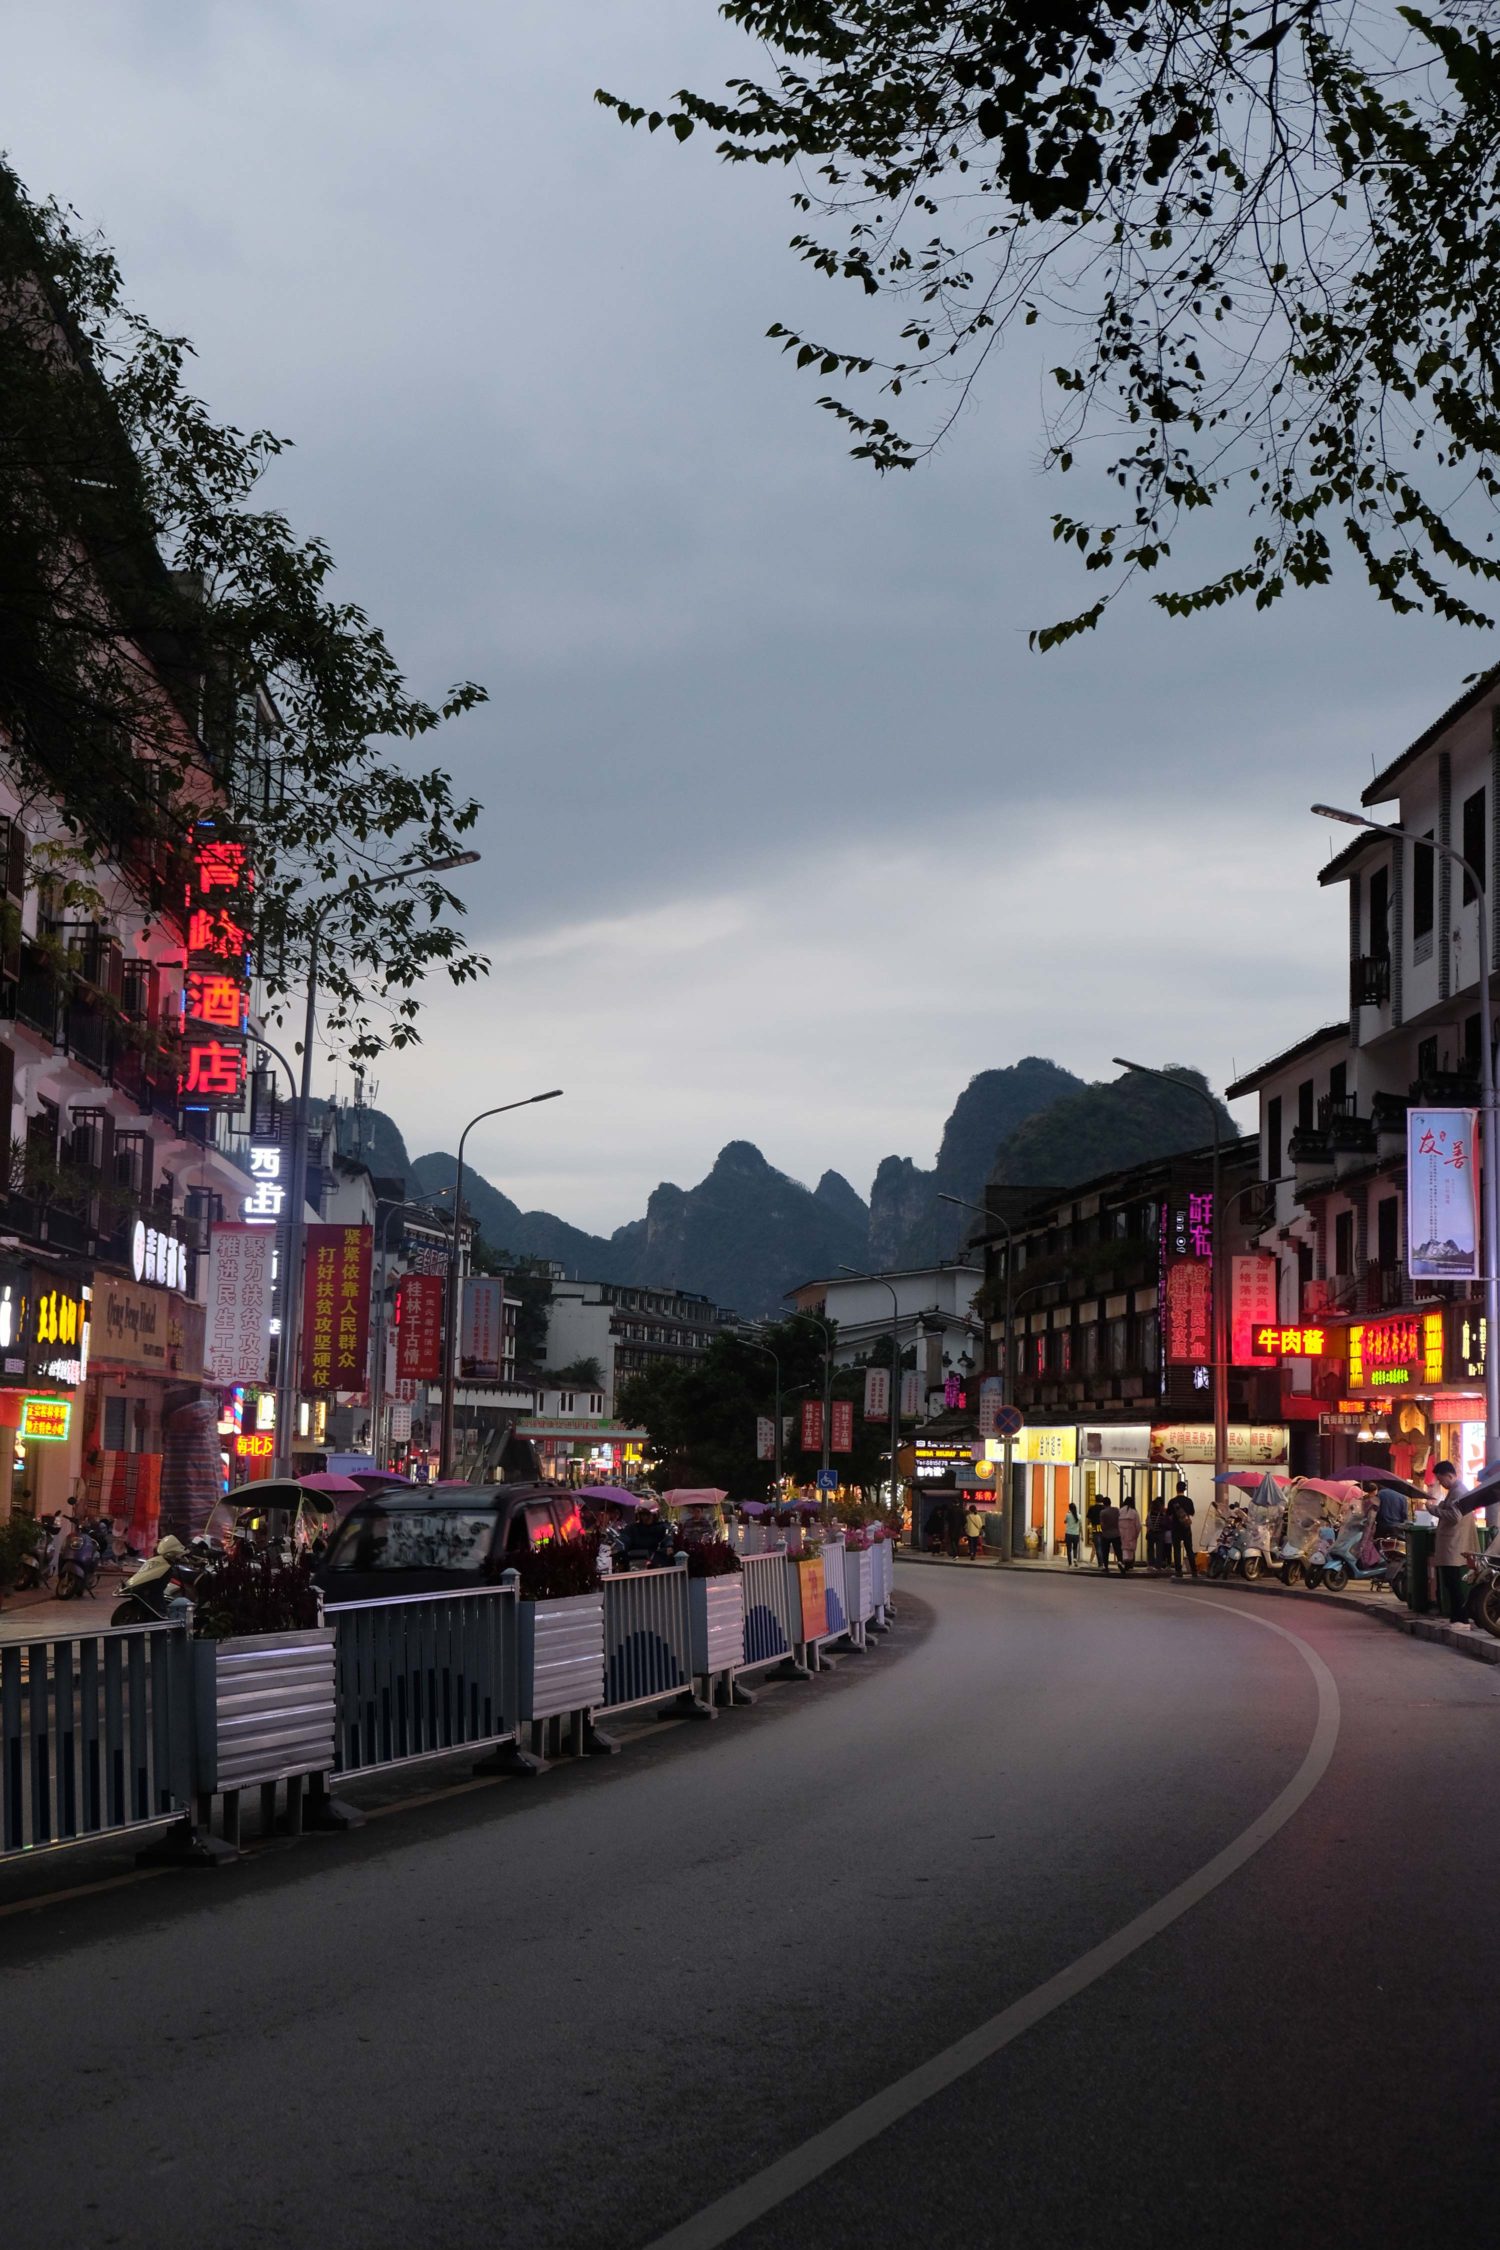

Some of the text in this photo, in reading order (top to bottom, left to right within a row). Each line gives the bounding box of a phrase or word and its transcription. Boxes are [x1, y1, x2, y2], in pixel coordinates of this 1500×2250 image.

[1418, 1128, 1469, 1169] 友善
[211, 1236, 240, 1379] 推进民生工程
[238, 1236, 266, 1379] 聚力扶贫攻坚
[312, 1248, 336, 1386] 打好扶贫攻坚硬仗
[337, 1229, 361, 1368] 紧紧依靠人民群众
[403, 1281, 423, 1365] 桂林千古情
[1258, 1328, 1325, 1355] 牛肉酱
